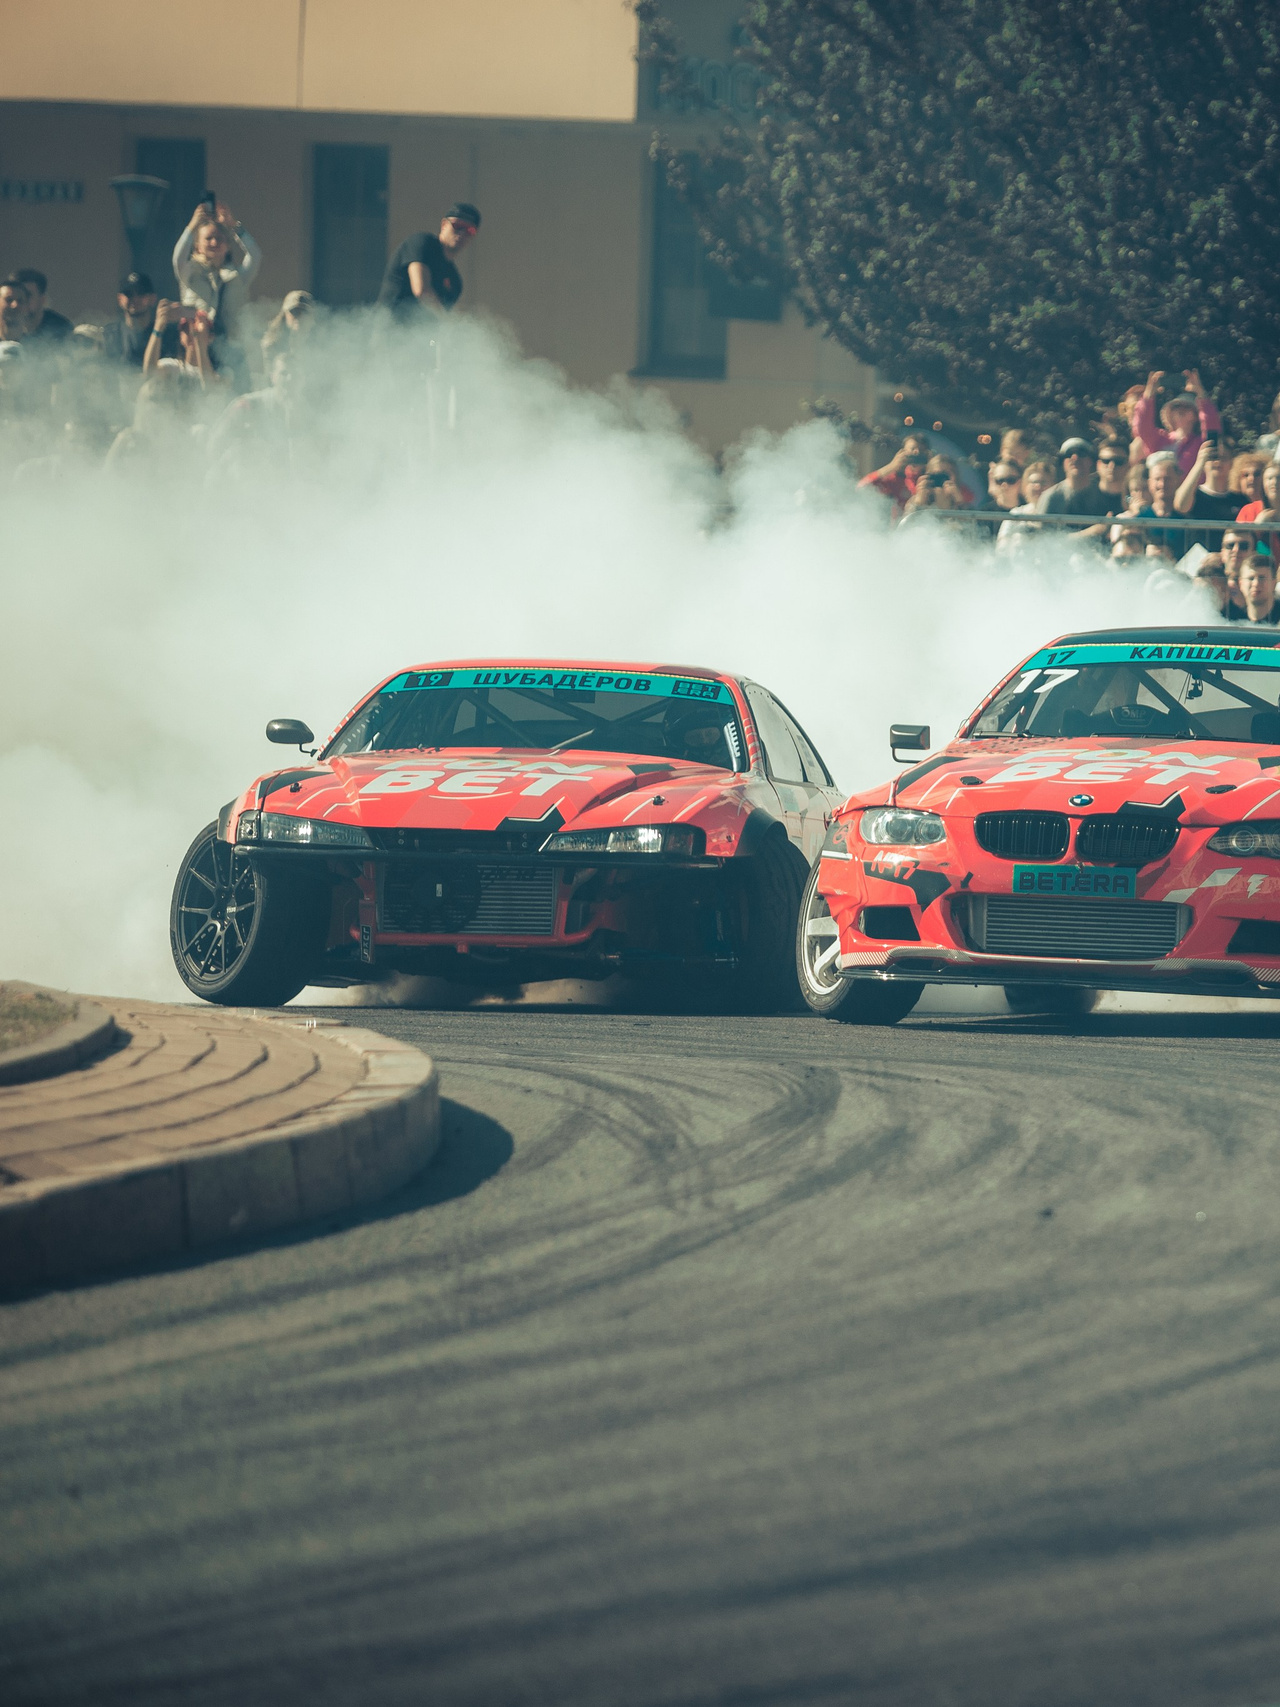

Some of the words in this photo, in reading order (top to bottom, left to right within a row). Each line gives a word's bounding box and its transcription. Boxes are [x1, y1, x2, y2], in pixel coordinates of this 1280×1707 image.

[1046, 650, 1077, 665] 17
[416, 673, 443, 687] 19
[473, 671, 653, 692] ШУБАДЁРОВ
[1013, 668, 1080, 694] 17
[373, 758, 607, 774] FON
[1003, 748, 1238, 768] FON
[358, 770, 594, 797] BET
[984, 761, 1221, 786] BET
